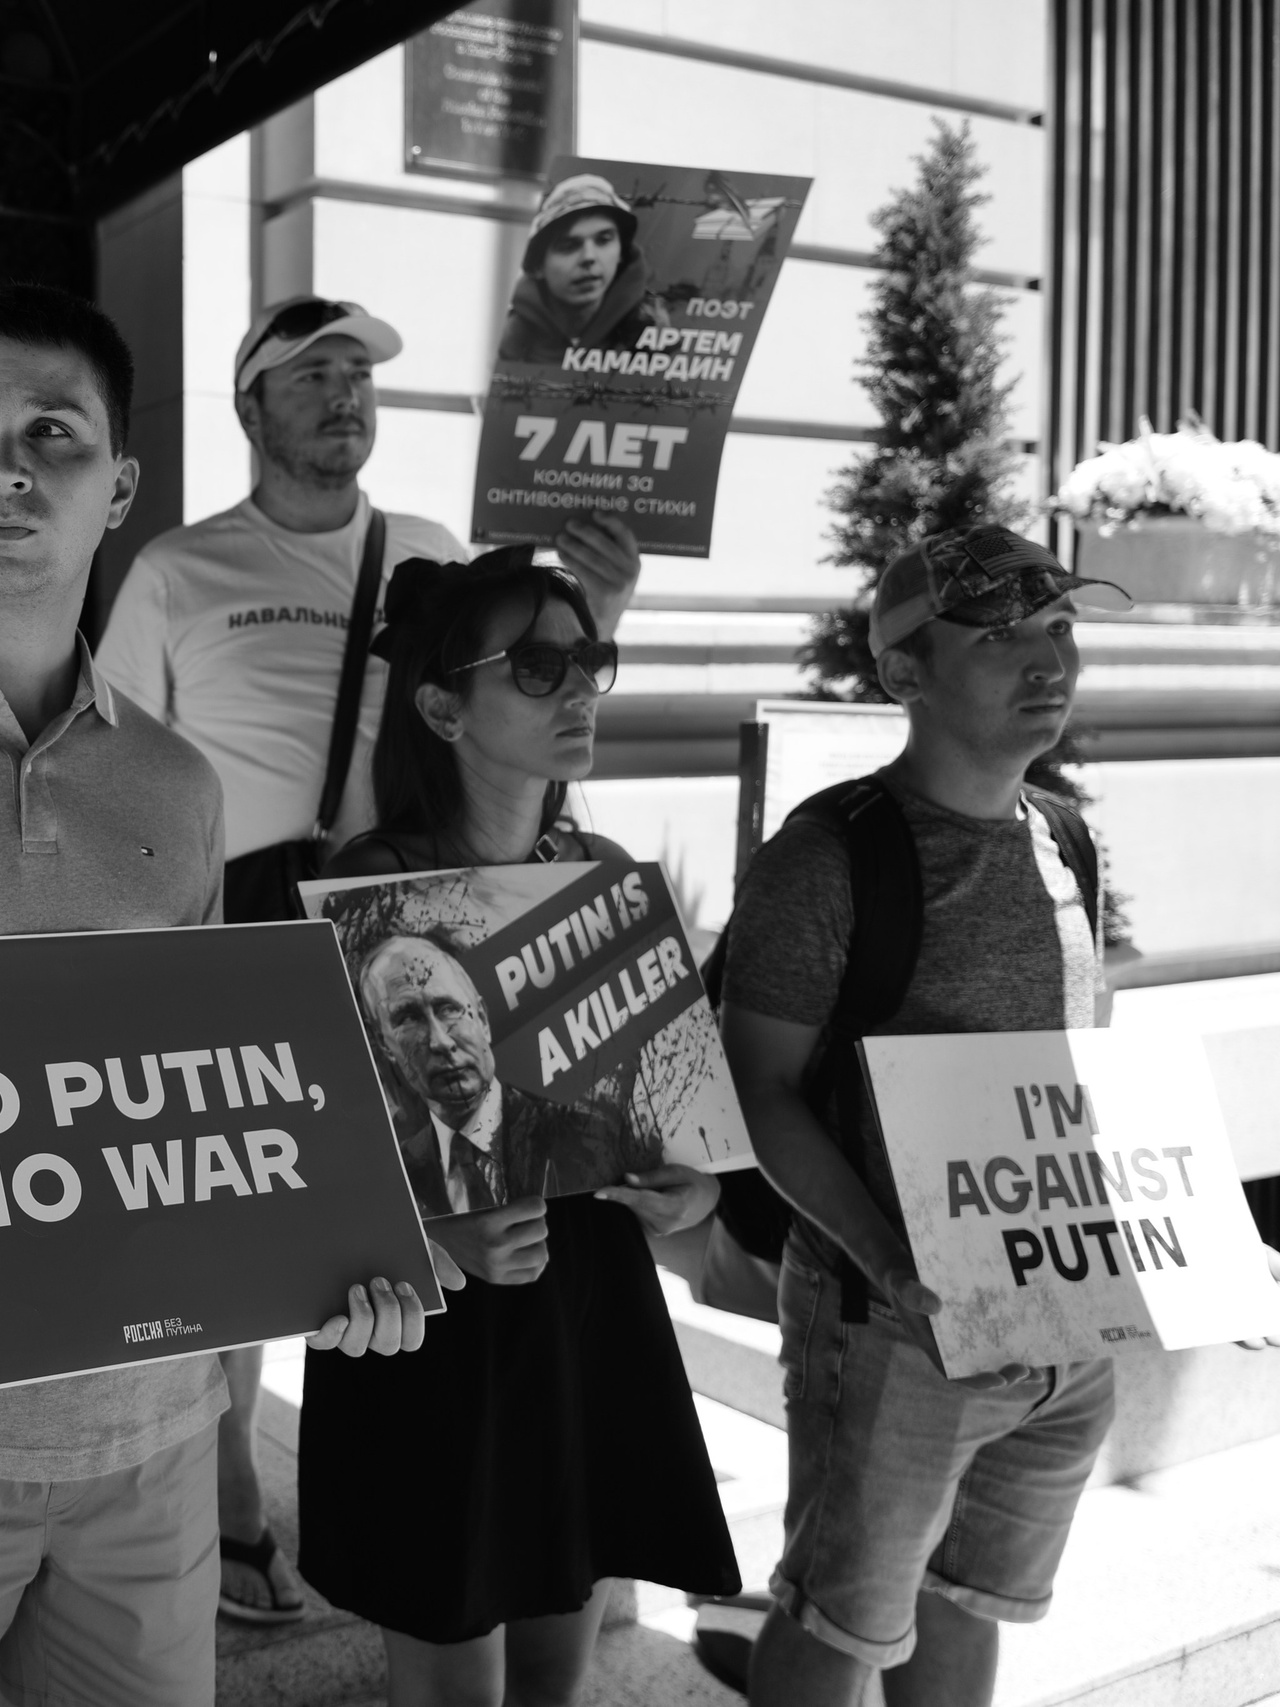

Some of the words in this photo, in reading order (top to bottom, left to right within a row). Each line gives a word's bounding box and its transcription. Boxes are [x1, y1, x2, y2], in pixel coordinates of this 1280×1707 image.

[686, 297, 753, 320] ПОЭТ
[561, 348, 734, 382] КАМАРДИН
[635, 327, 743, 356] АРТЕМ
[514, 415, 557, 462] 7
[564, 420, 688, 471] ЛЕТ
[228, 606, 385, 630] НАВАЛЬН
[494, 894, 616, 1012] PUTIN
[610, 871, 649, 930] IS
[536, 1026, 572, 1087] A
[563, 935, 690, 1062] KILLER
[45, 1042, 326, 1127] PUTIN,
[1013, 1082, 1101, 1140] I'M
[101, 1128, 308, 1211] WAR
[946, 1145, 1195, 1218] AGAINST
[1002, 1216, 1188, 1287] PUTIN
[123, 1320, 164, 1344] РОССИЯ
[164, 1317, 182, 1328] БЕЗ
[166, 1323, 203, 1337] ПУТИНА
